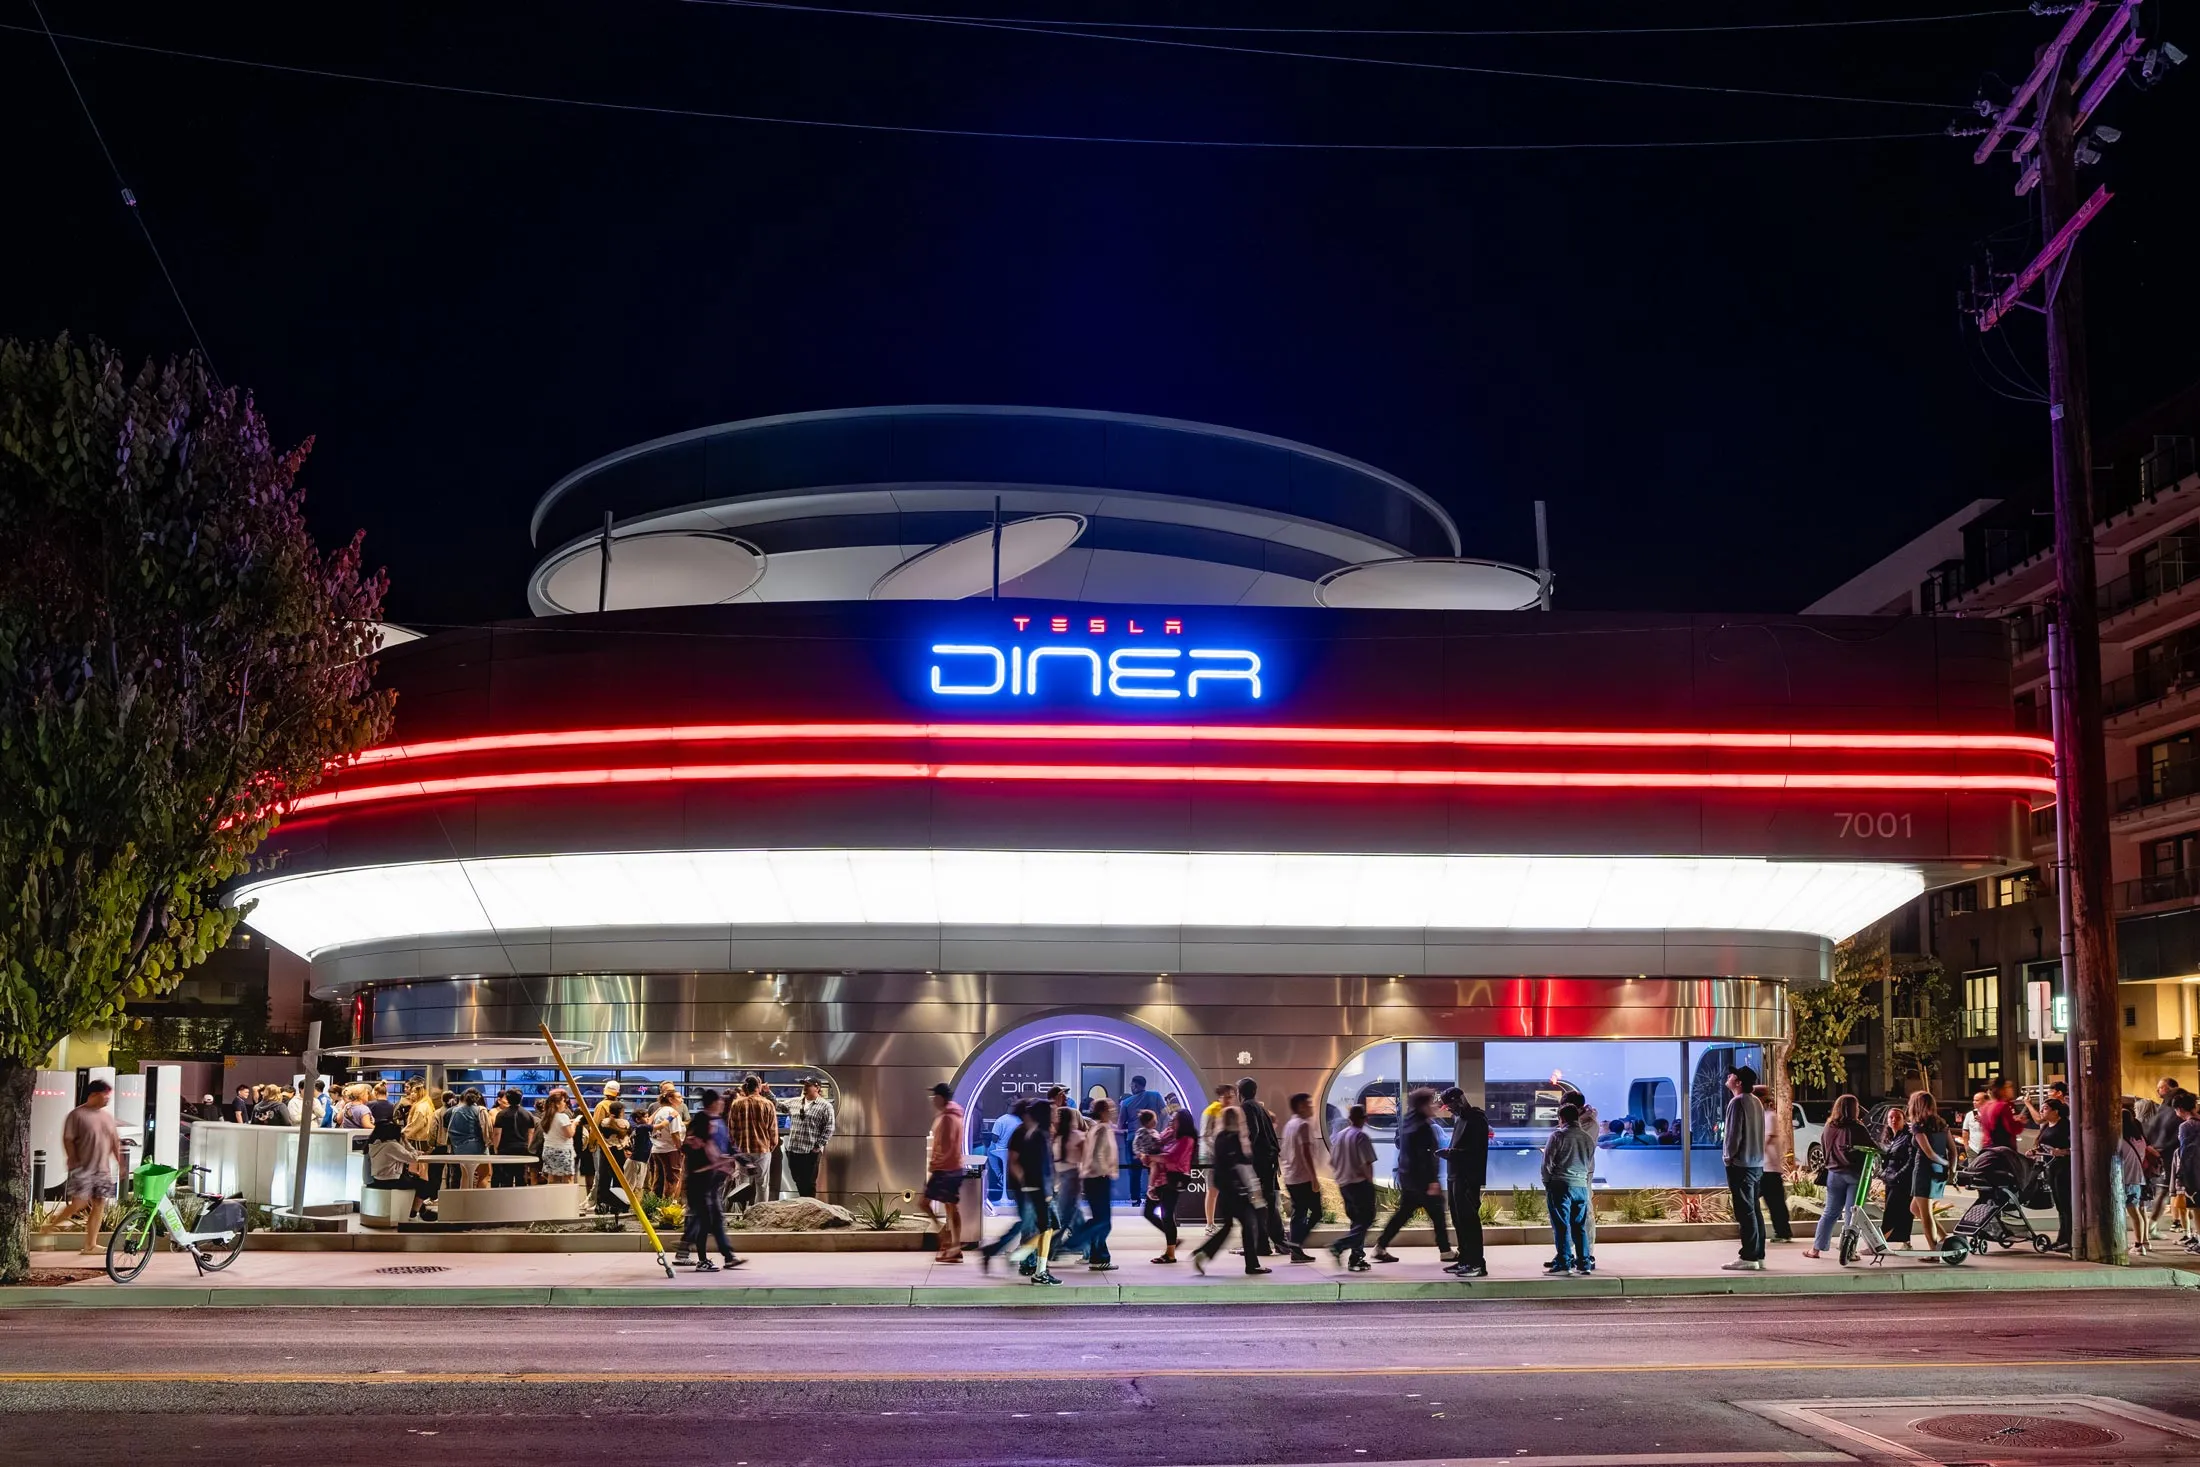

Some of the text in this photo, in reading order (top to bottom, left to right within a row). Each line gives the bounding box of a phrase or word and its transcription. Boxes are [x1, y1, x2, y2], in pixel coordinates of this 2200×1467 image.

[1013, 618, 1182, 635] TESLA
[931, 644, 1261, 699] DINER
[1833, 811, 1912, 838] 7001
[1001, 1081, 1064, 1093] DINE
[1190, 1168, 1206, 1179] EX
[1187, 1182, 1206, 1193] ON
